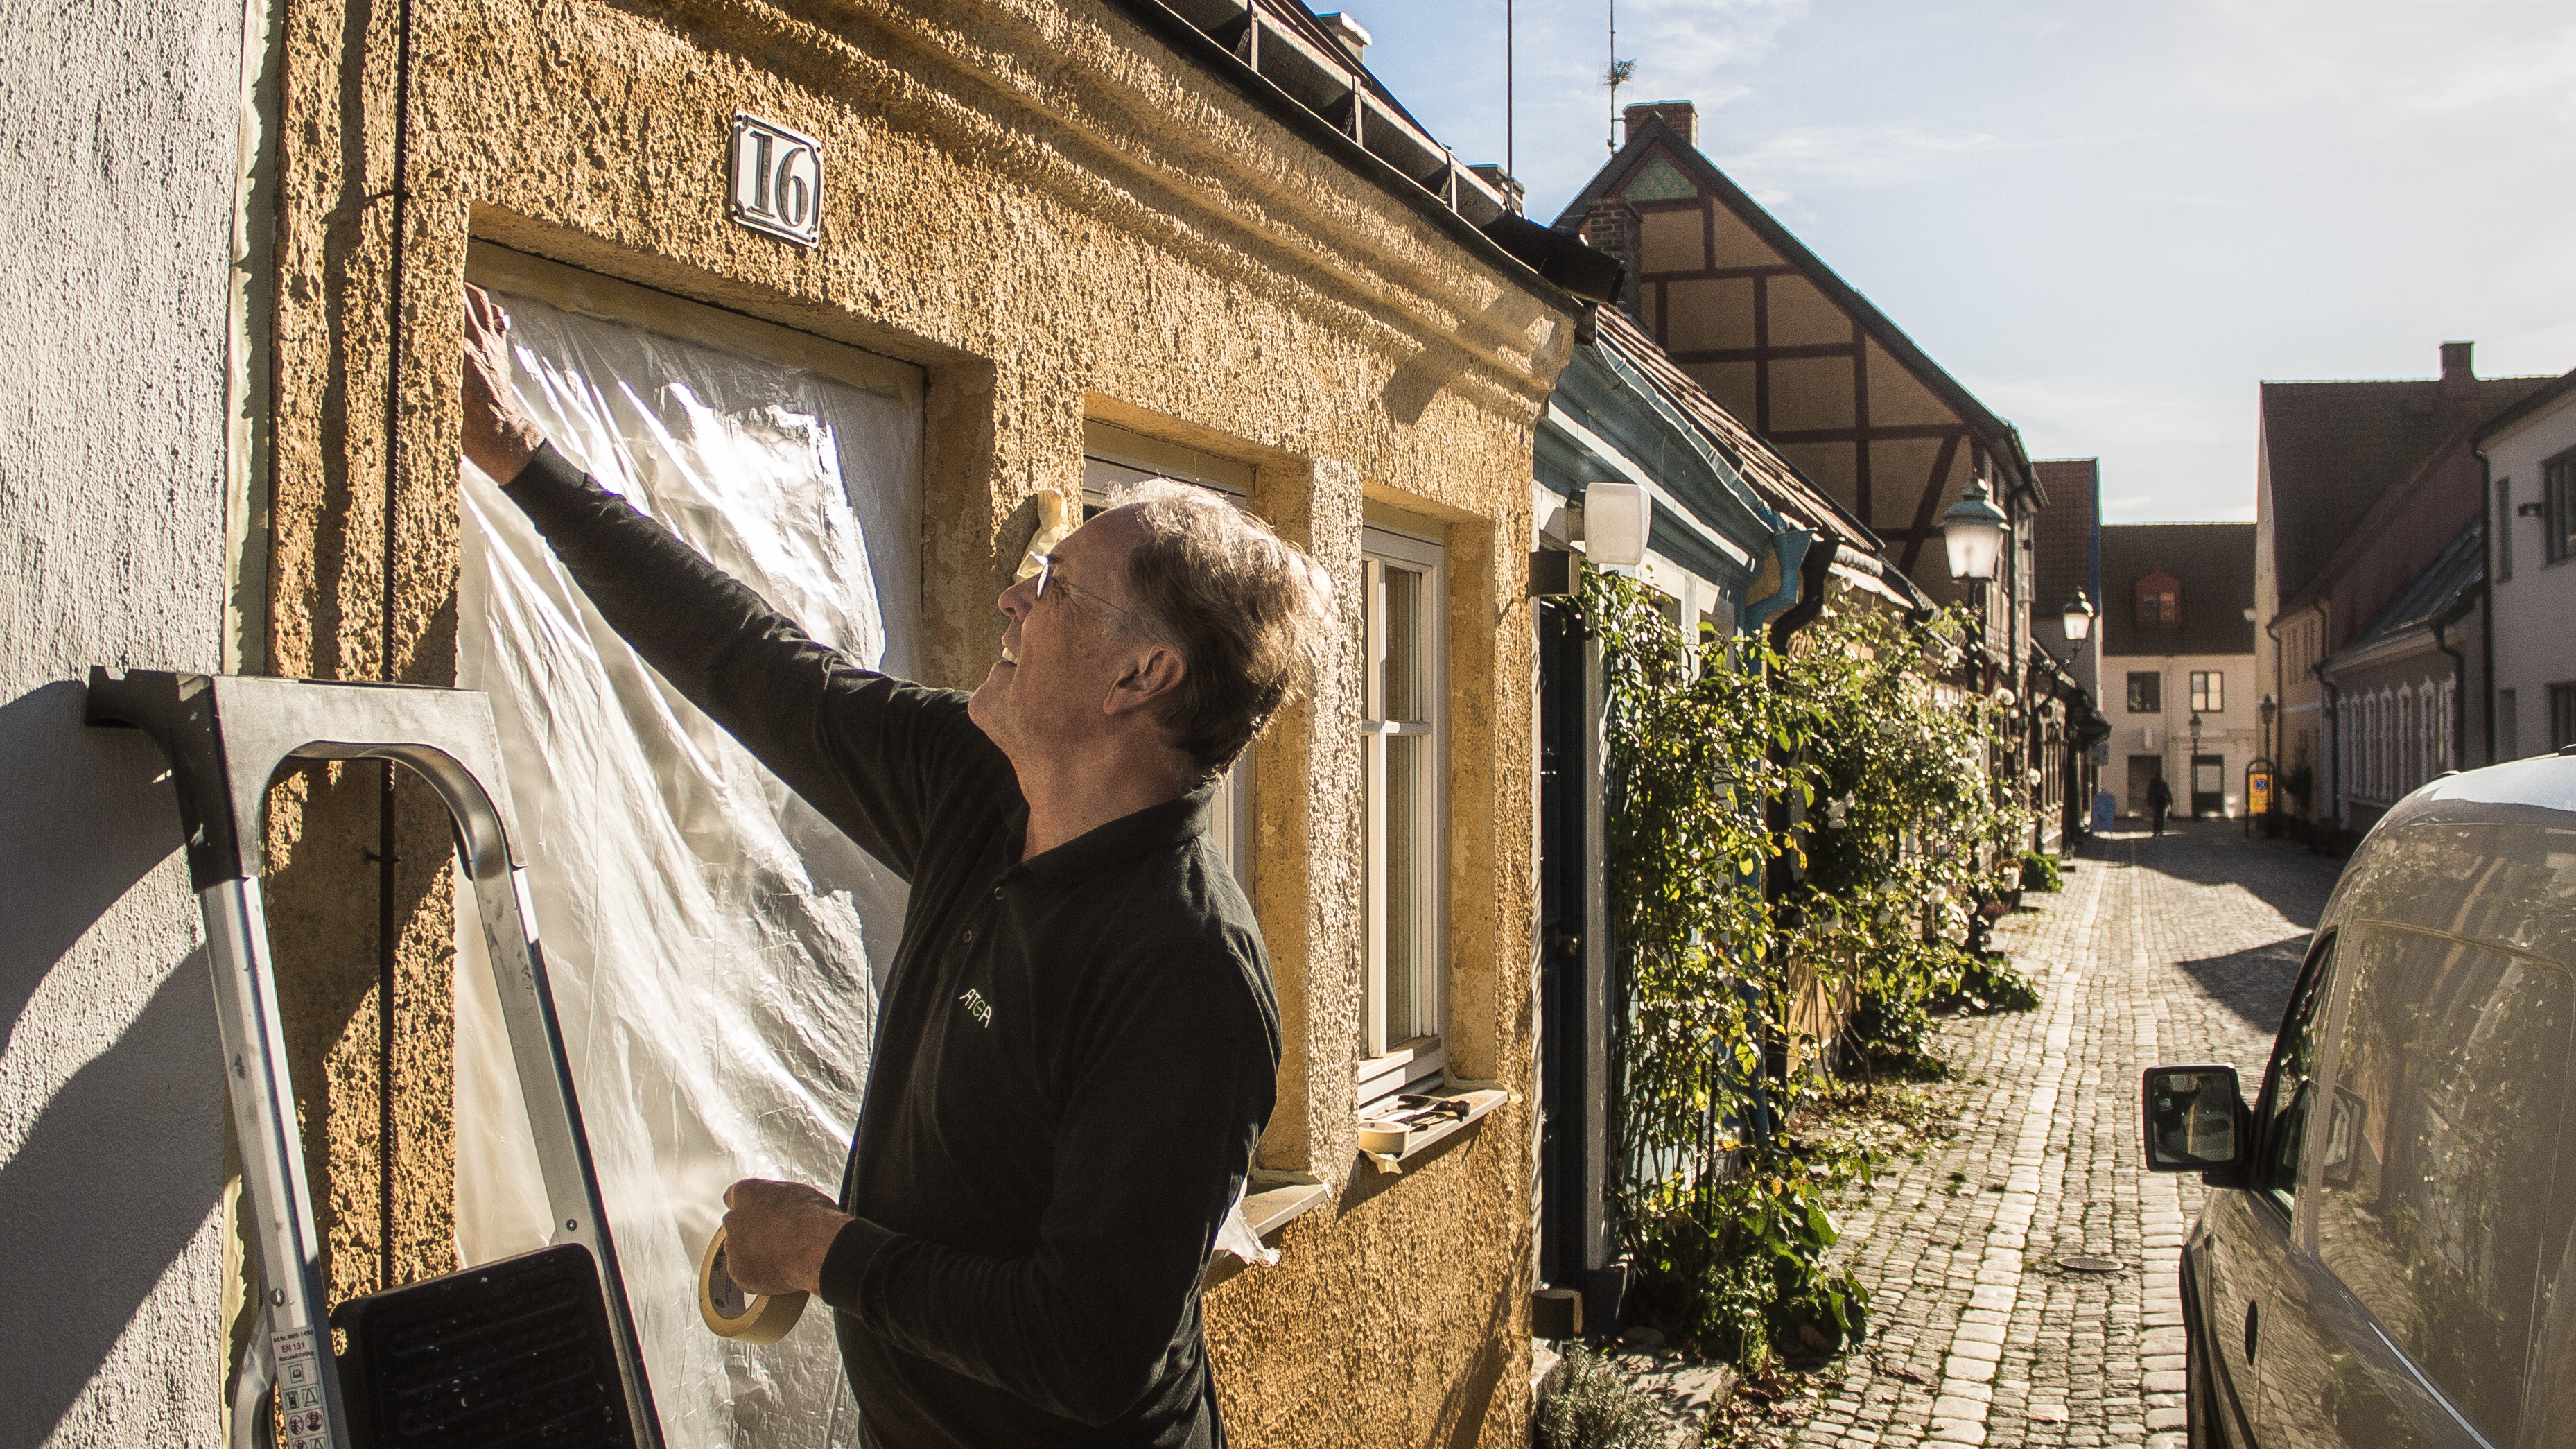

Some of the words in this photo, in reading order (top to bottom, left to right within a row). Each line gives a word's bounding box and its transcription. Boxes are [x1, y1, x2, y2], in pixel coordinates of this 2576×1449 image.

[745, 130, 809, 227] 16
[281, 1344, 291, 1353] EN
[293, 1341, 304, 1351] 131
